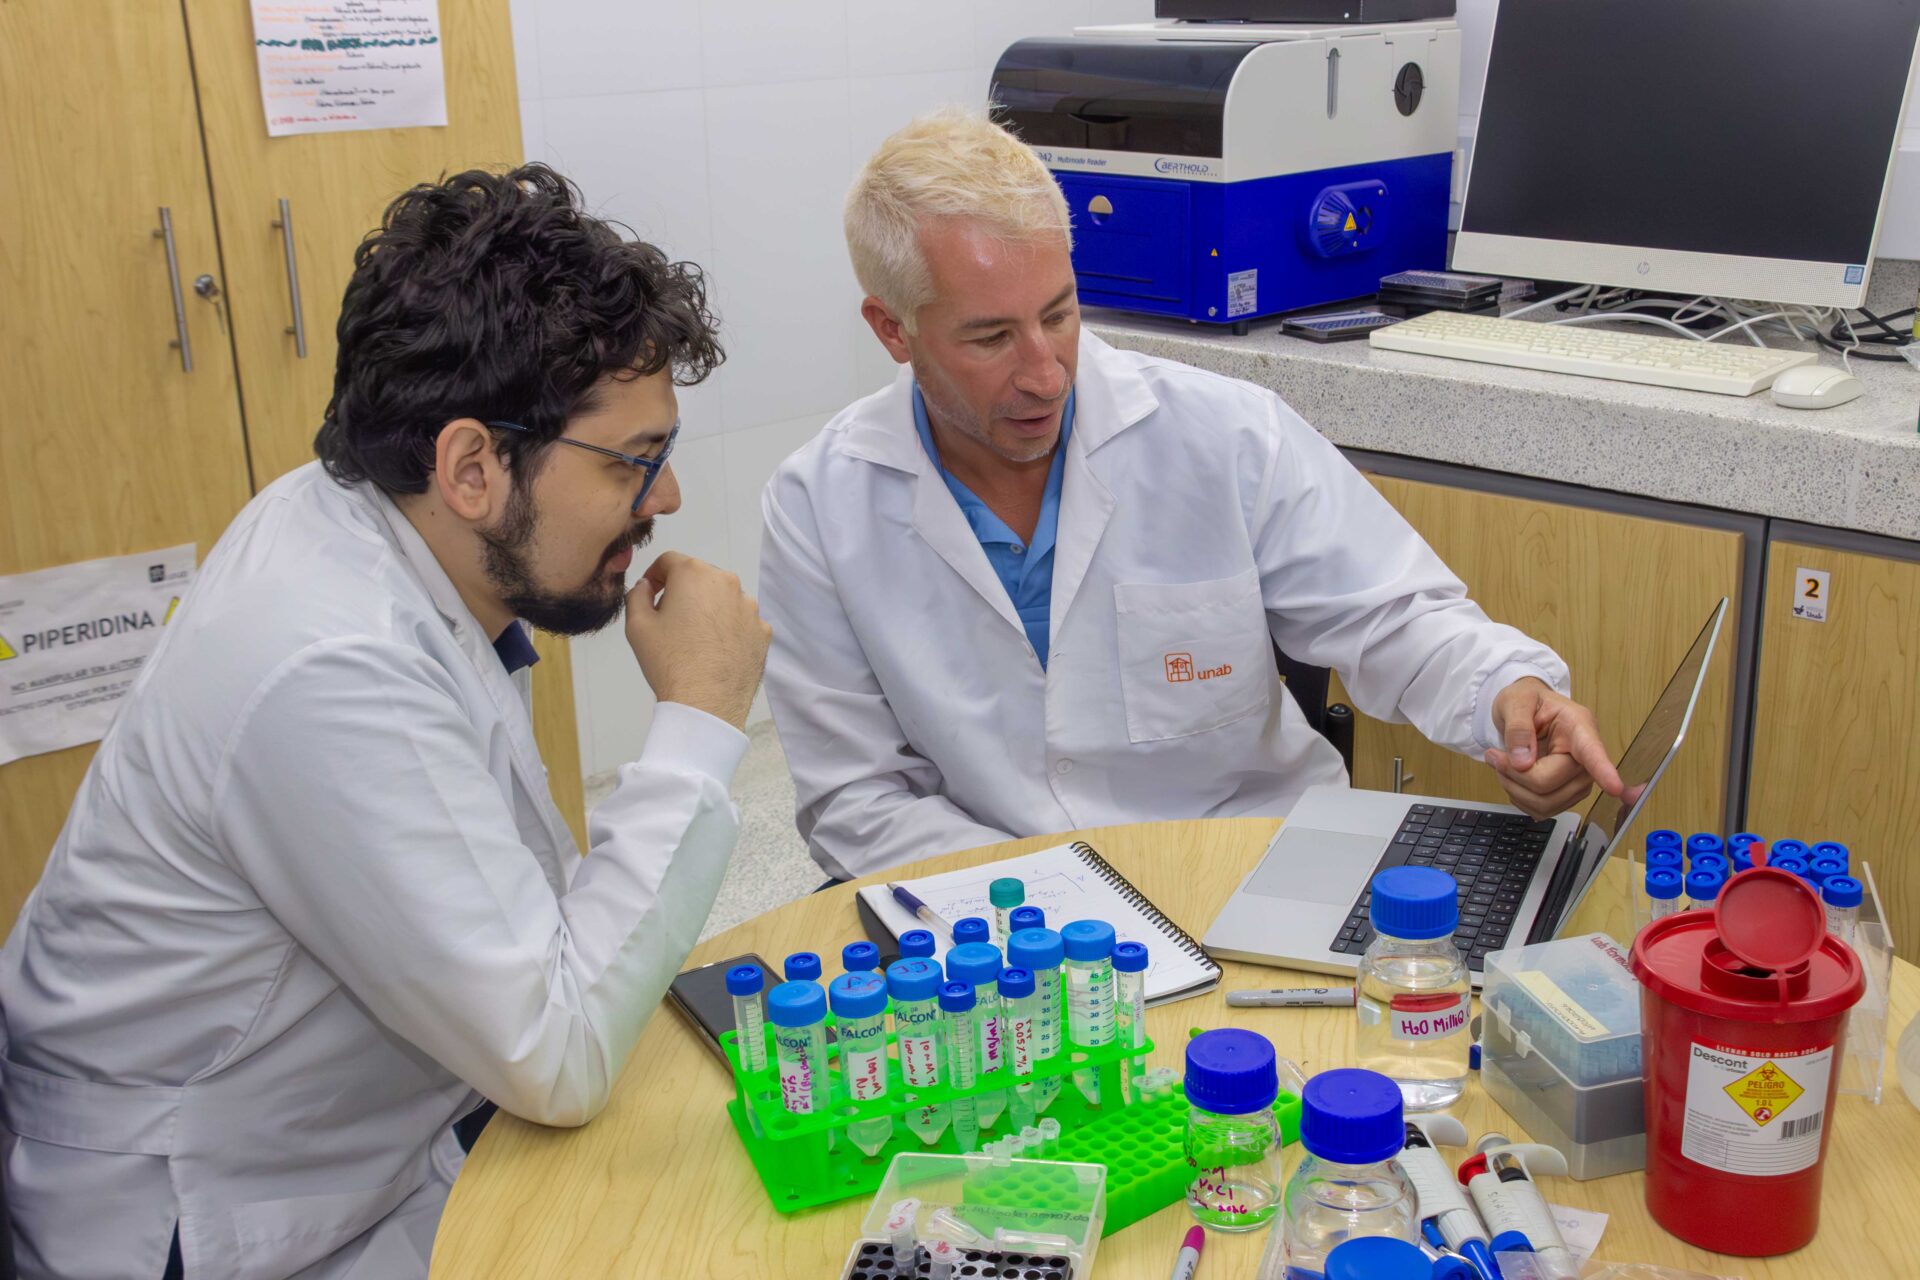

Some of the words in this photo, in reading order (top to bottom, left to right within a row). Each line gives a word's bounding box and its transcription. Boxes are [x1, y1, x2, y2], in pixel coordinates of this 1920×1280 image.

[1805, 578, 1819, 599] 2
[22, 610, 156, 653] PIPERIDINA
[1197, 664, 1232, 680] unab
[841, 1023, 882, 1039] FALCON
[1401, 1019, 1429, 1035] H2O
[1433, 1009, 1464, 1032] MilliQ
[1693, 1046, 1748, 1069] Descont
[1747, 1080, 1785, 1089] PELIGRO
